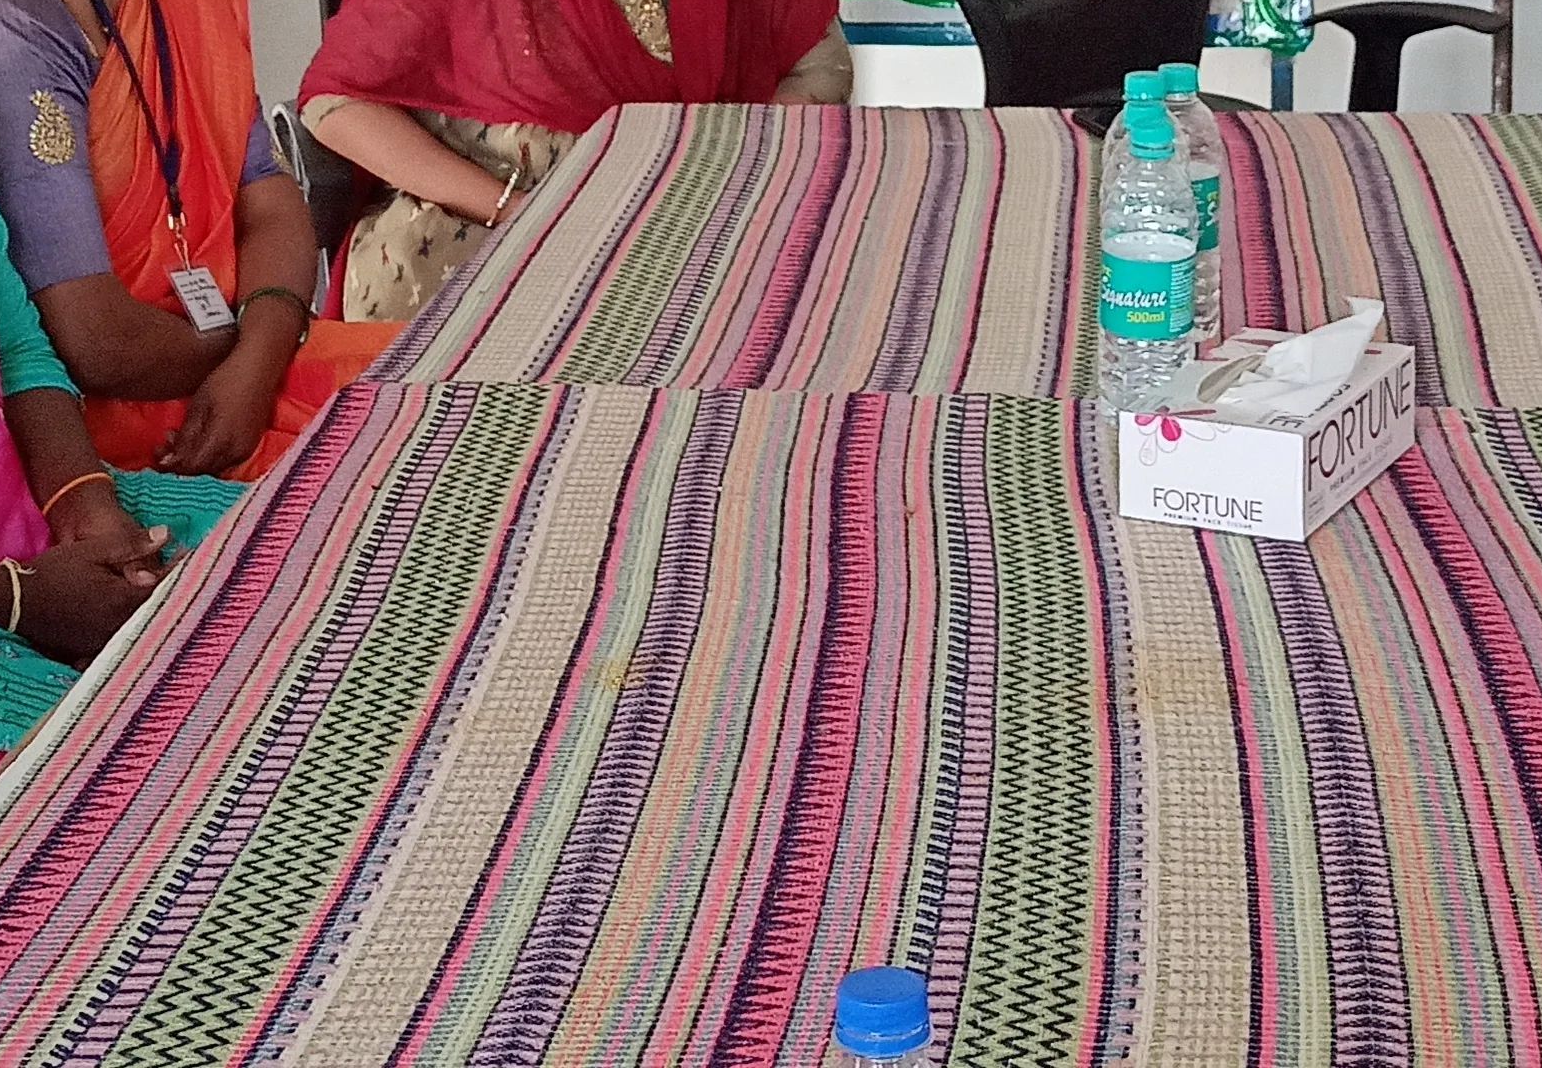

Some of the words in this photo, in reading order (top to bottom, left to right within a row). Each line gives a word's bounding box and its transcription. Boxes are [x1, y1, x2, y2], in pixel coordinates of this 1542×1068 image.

[1126, 311, 1165, 324] 500ml
[1308, 358, 1412, 493] FORTUNE
[1152, 486, 1263, 523] FORTUNE
